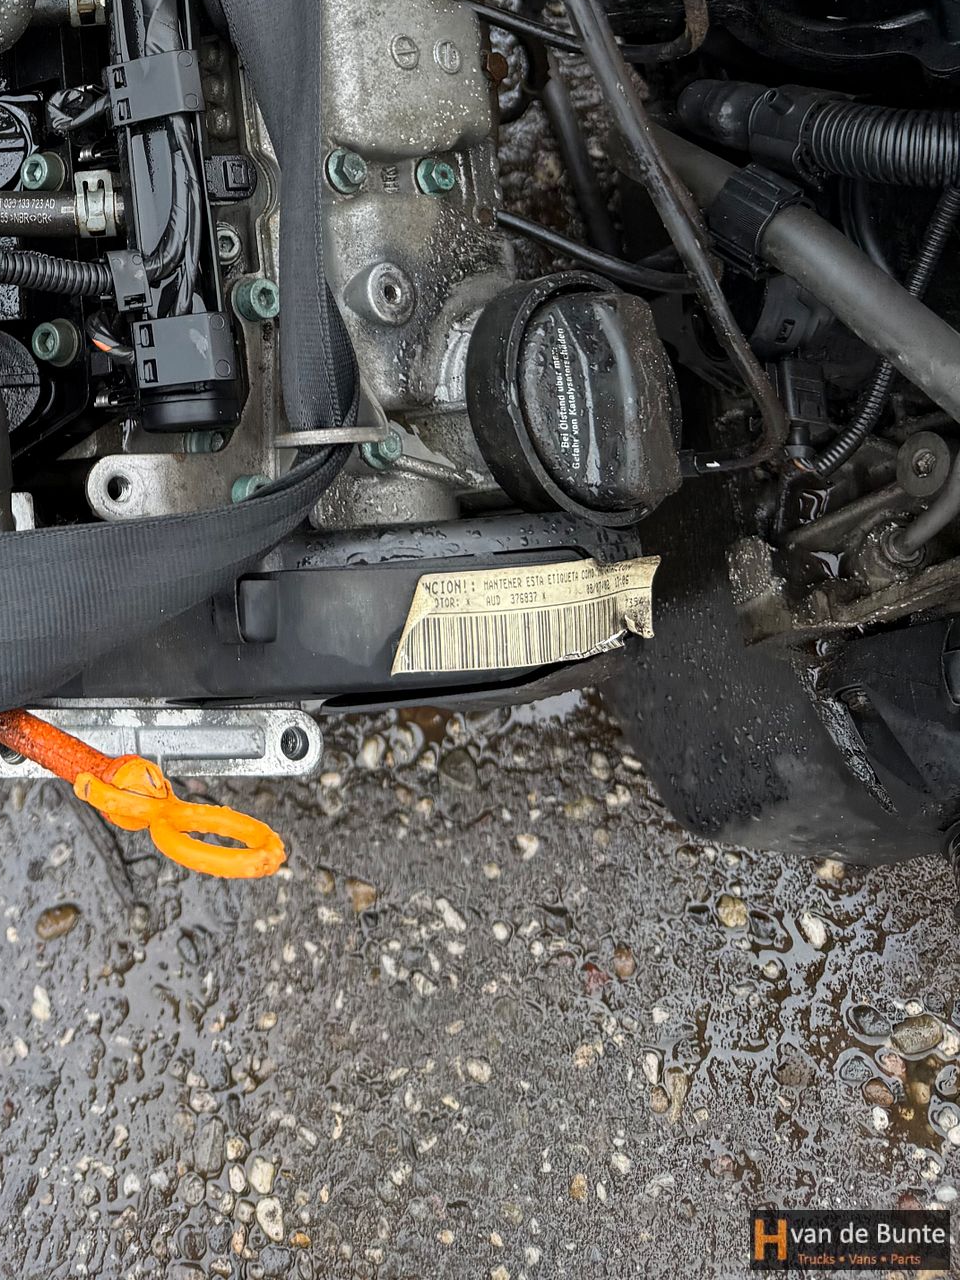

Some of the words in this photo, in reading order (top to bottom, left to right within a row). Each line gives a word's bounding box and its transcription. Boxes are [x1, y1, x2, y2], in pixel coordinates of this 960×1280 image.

[571, 418, 579, 436] von
[560, 433, 571, 449] Bei
[570, 438, 581, 470] Gefahr
[484, 576, 523, 591] MANTENER
[526, 576, 544, 588] ESTA
[486, 594, 501, 607] AUD
